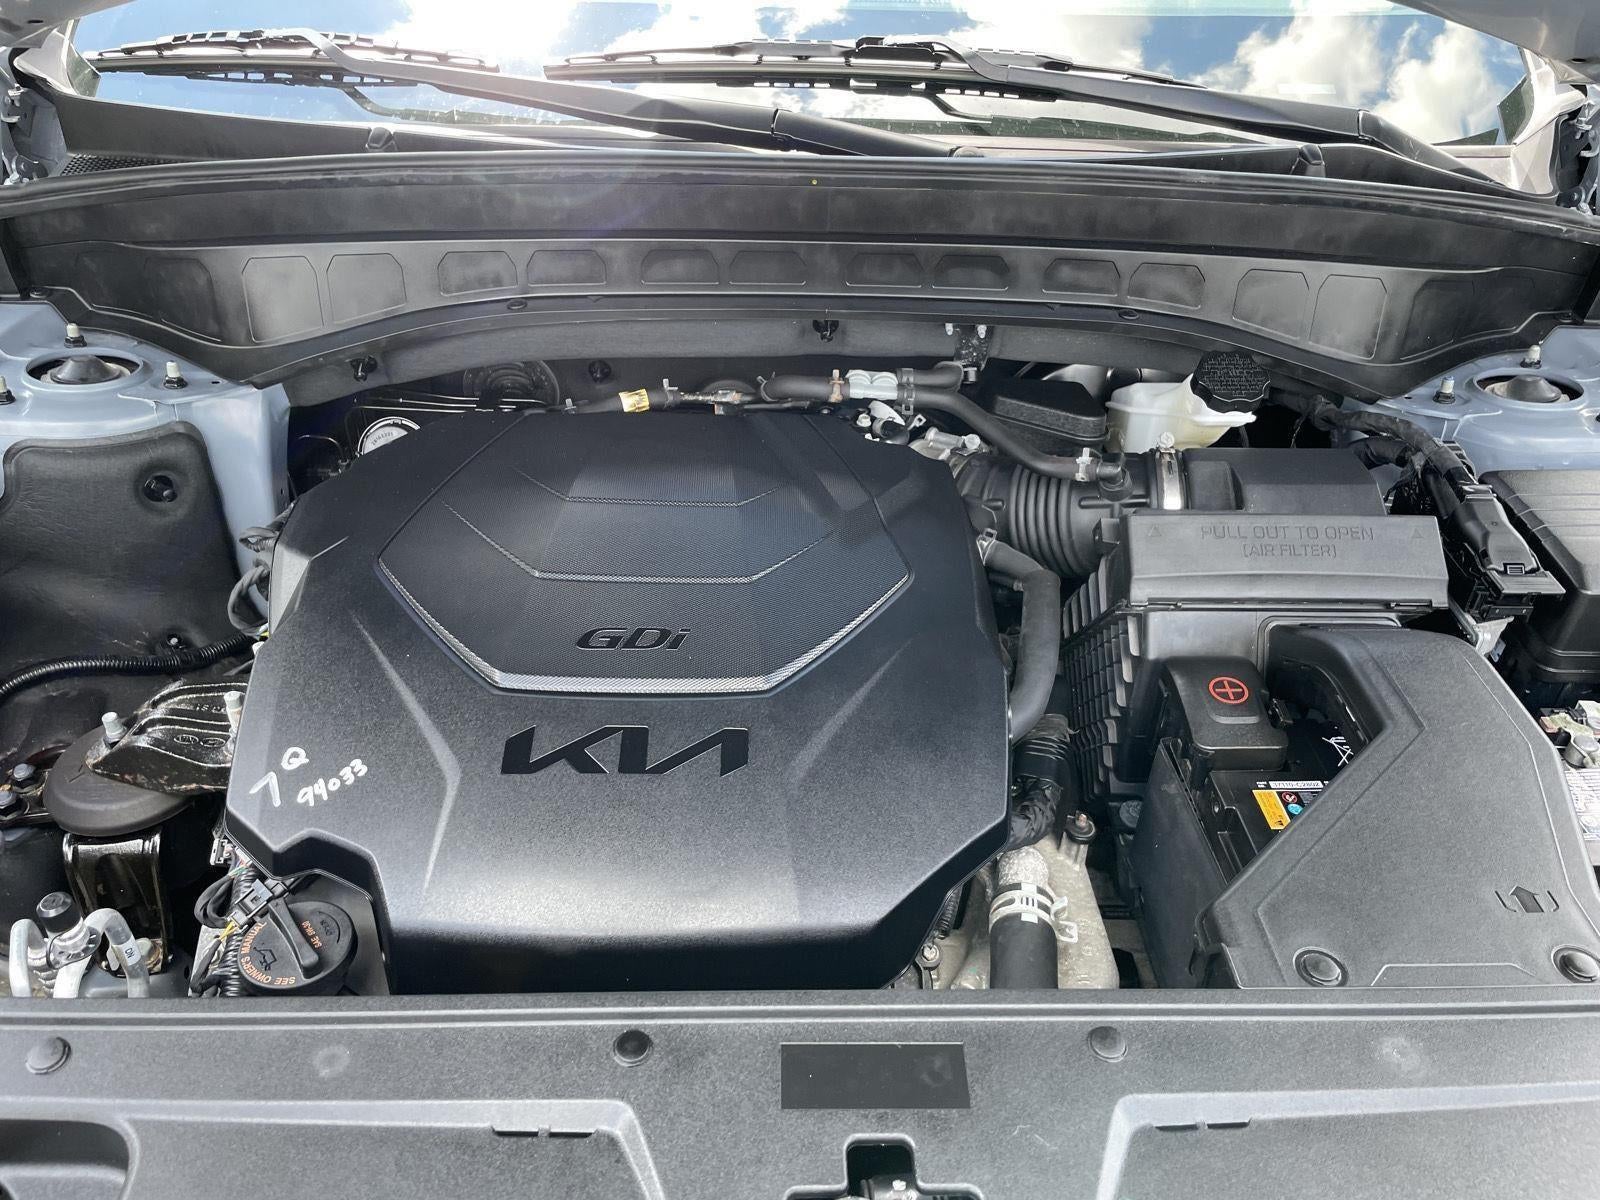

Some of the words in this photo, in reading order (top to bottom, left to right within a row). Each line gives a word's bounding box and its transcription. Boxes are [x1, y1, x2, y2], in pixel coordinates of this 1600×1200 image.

[1201, 525, 1247, 539] PULL
[1252, 525, 1290, 540] OUT
[1294, 525, 1319, 540] TO
[1324, 526, 1374, 541] OPEN
[576, 627, 691, 651] GDi
[501, 724, 748, 777] KIA
[297, 758, 368, 806] 94033
[240, 921, 267, 954] MANUAL
[310, 935, 323, 949] SAE
[241, 956, 272, 984] OWNER'S
[274, 976, 296, 985] SEE
